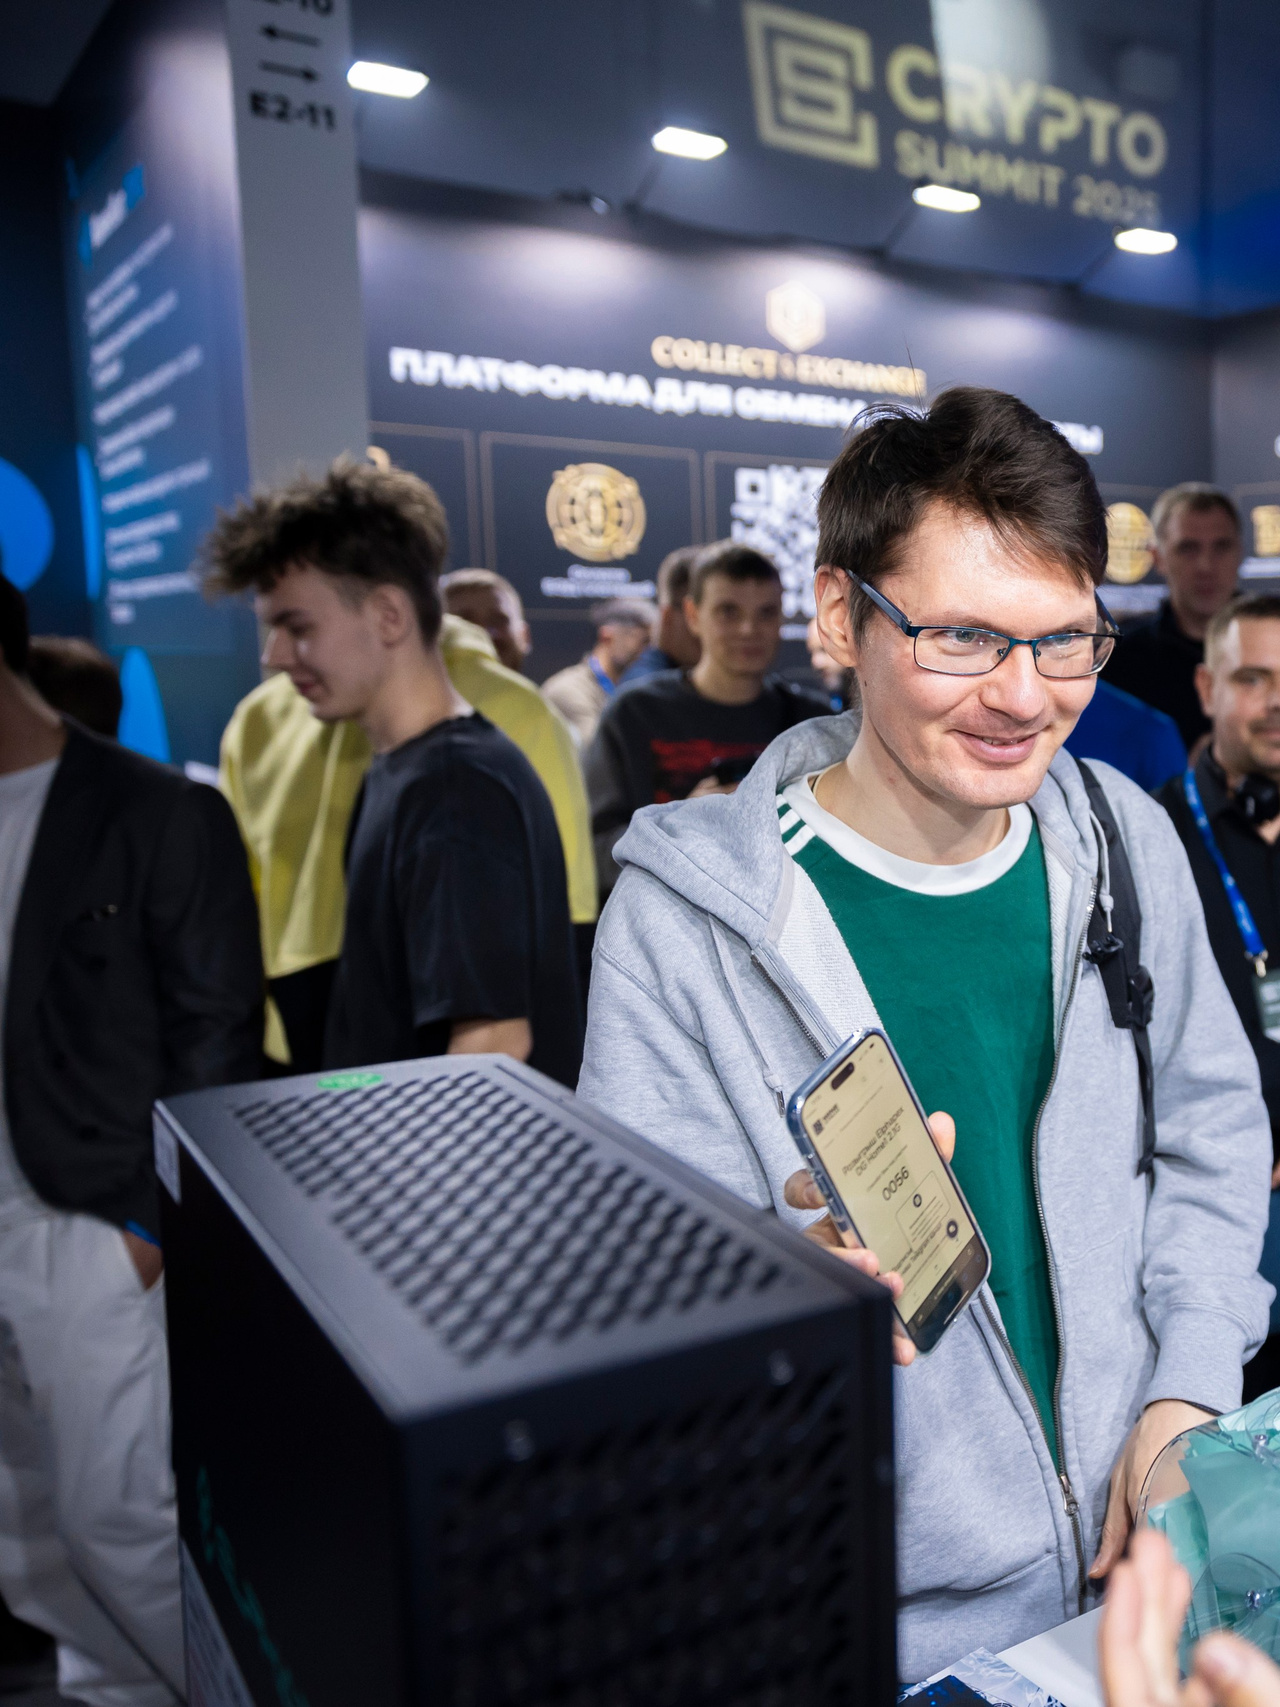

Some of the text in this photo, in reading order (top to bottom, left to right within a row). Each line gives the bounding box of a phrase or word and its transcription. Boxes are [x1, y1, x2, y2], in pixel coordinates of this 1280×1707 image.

[249, 90, 337, 131] E2-11
[886, 44, 1168, 177] CRYPTO
[895, 129, 1065, 207] SUMMIT
[389, 346, 653, 409] ПЛАТФОРМА
[653, 376, 733, 417] ДЛЯ
[651, 335, 778, 380] COLLECT
[882, 1166, 909, 1201] 0056
